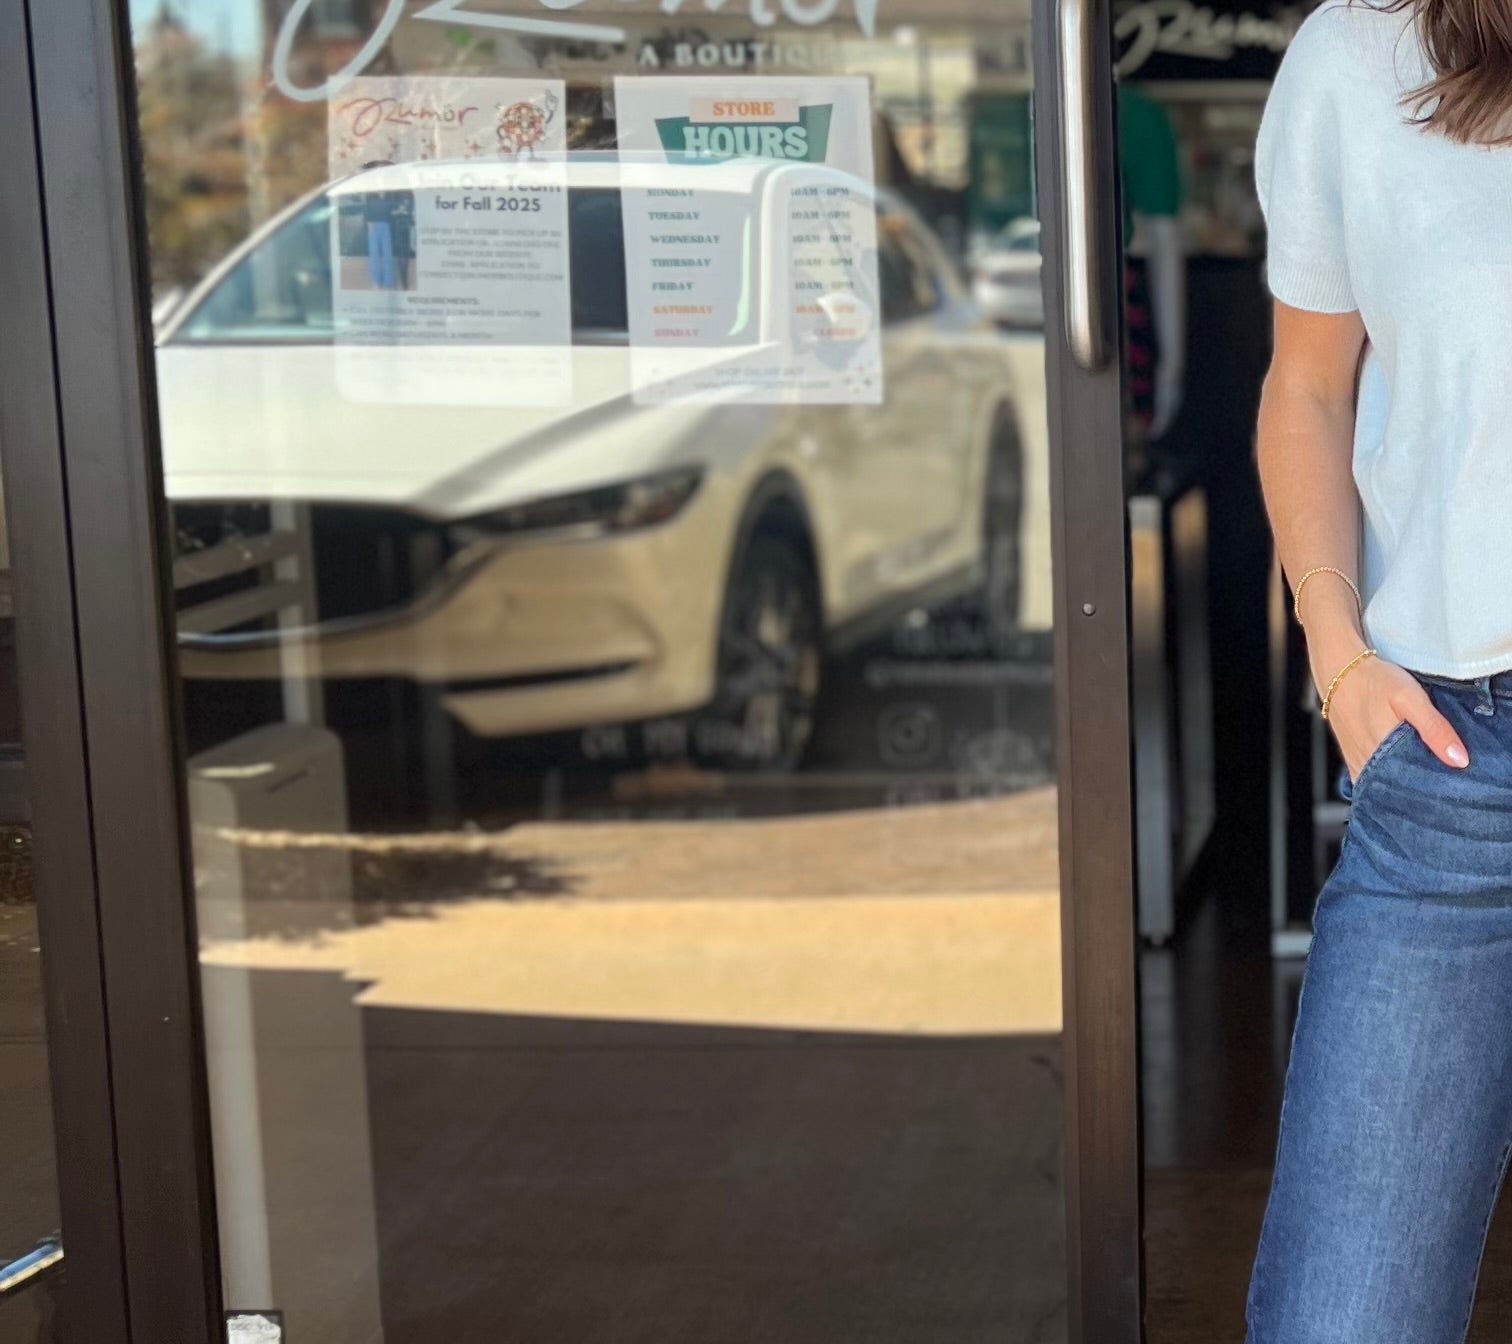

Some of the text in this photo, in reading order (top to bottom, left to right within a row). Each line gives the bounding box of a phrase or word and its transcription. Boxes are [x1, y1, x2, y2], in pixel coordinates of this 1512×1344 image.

[640, 44, 659, 67] A
[712, 102, 775, 117] STORE
[682, 125, 809, 158] HOURS
[434, 195, 541, 212] for Fall 2025
[648, 211, 701, 221] TUESDAY
[650, 235, 720, 245] WEDNESDAY
[651, 258, 711, 268] THURSDAY
[652, 281, 694, 291] FRIDAY
[653, 304, 713, 314] SATURDAY
[654, 328, 700, 337] SUNDAY
